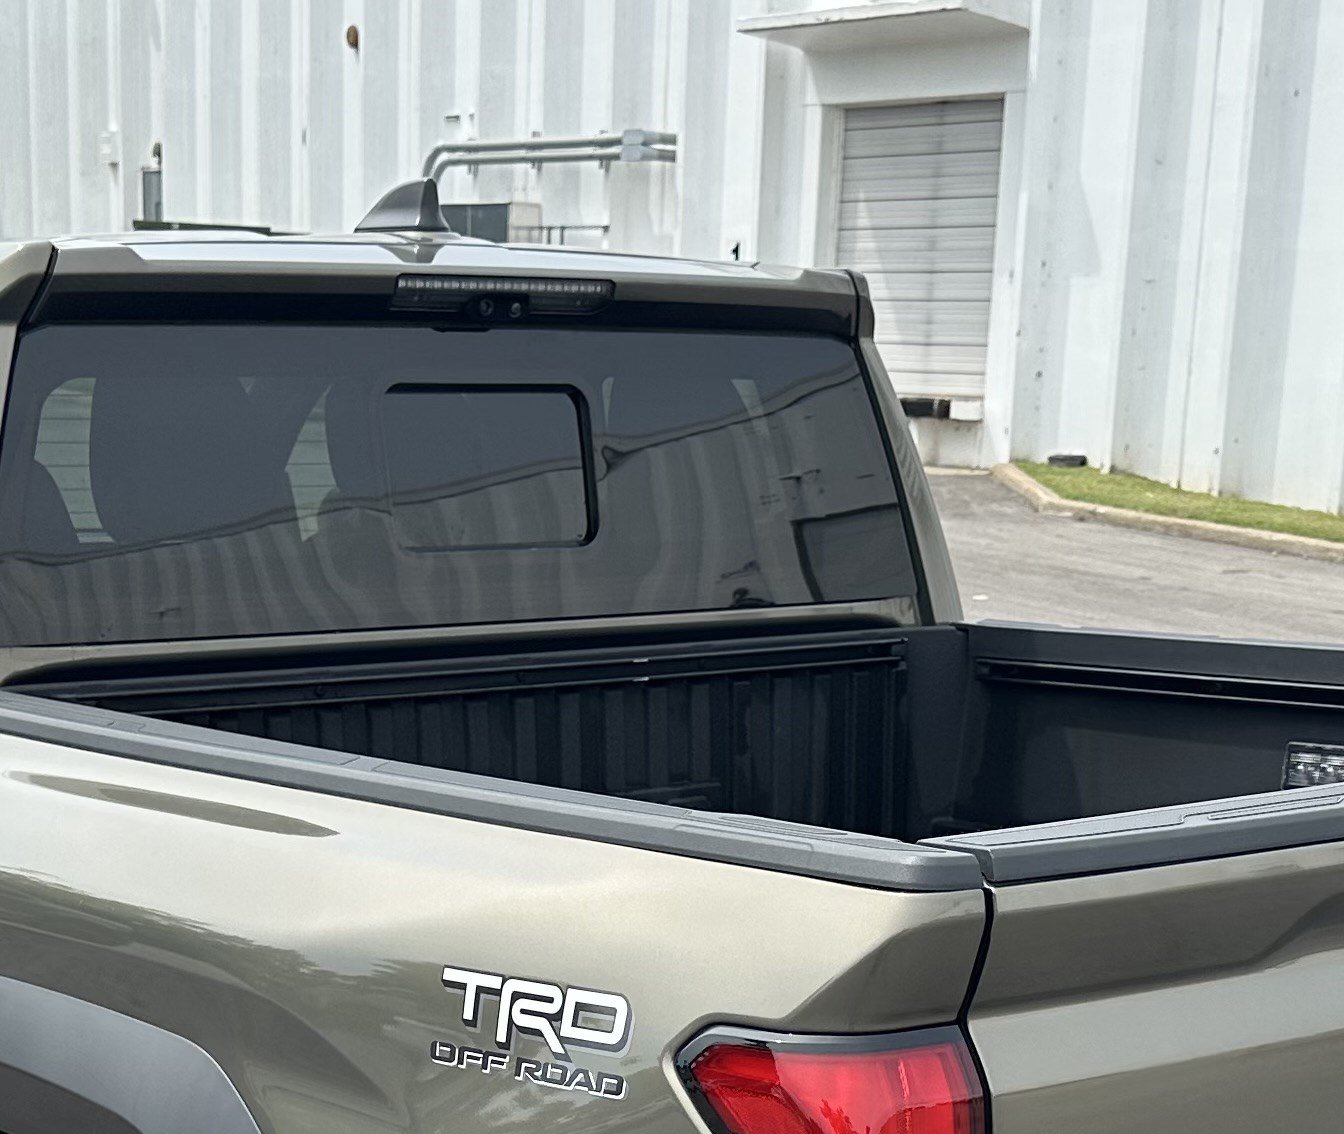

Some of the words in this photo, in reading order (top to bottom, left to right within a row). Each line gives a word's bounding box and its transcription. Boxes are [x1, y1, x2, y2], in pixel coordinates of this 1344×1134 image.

[441, 964, 632, 1063] TRD
[430, 1040, 509, 1074] OFF
[514, 1056, 628, 1100] ROAD
